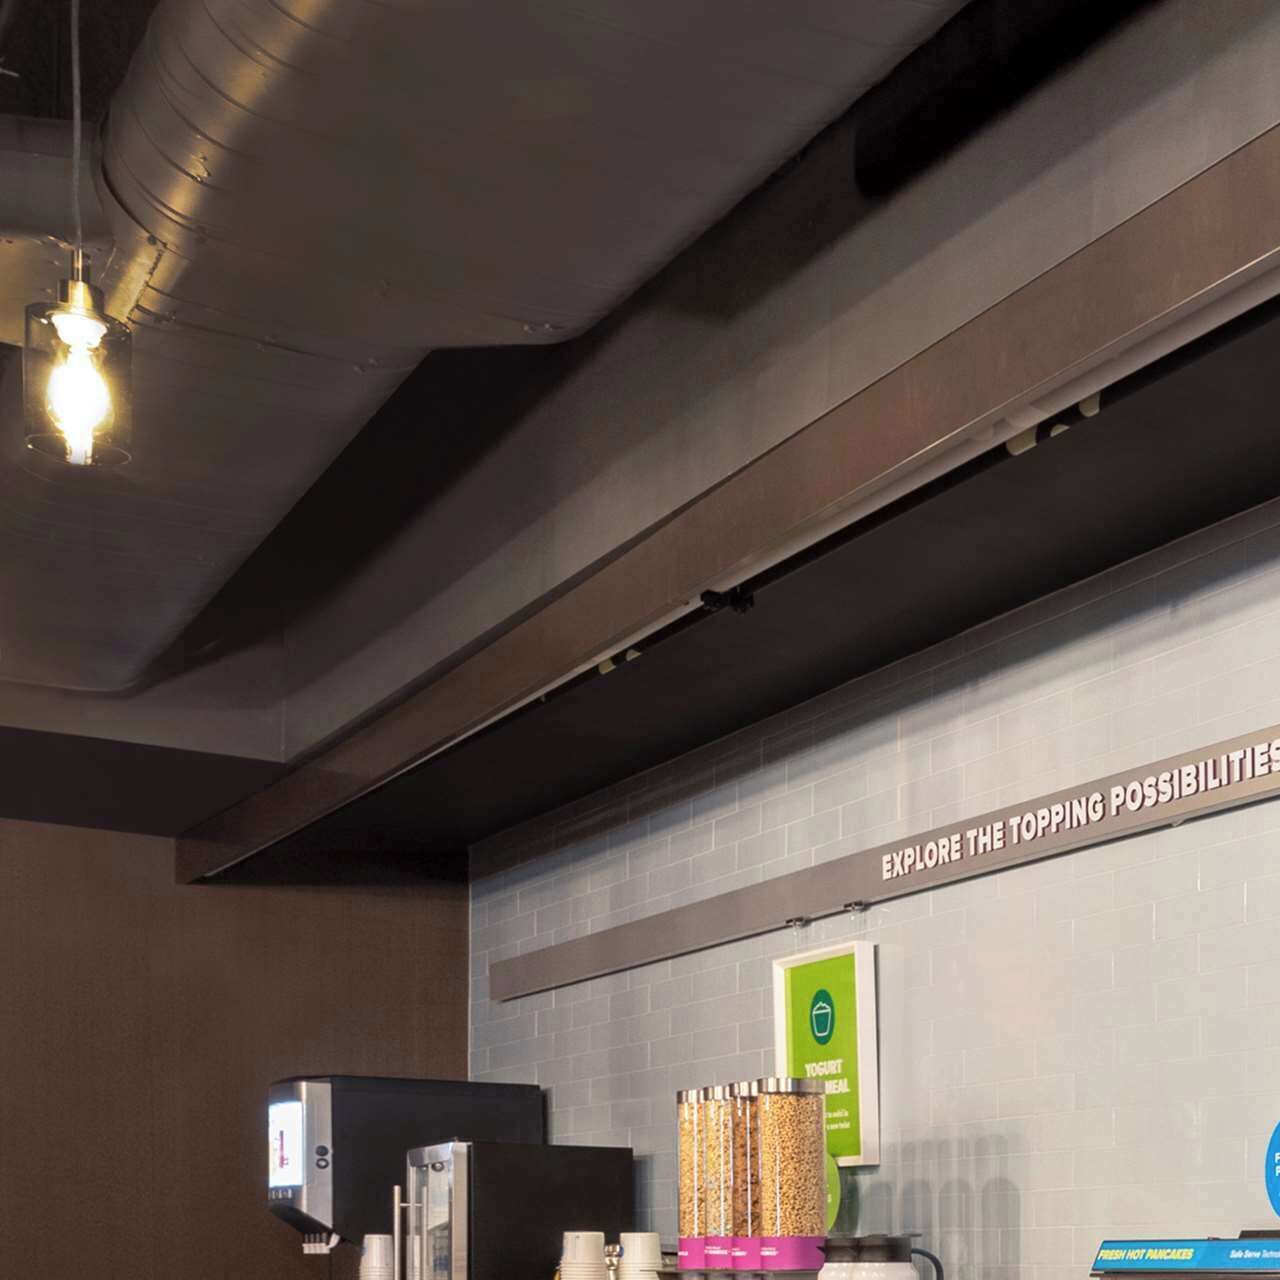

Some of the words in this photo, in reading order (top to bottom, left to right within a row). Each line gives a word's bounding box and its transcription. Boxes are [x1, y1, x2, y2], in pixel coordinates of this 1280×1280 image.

[881, 835, 963, 880] EXPLORE
[966, 823, 1005, 857] THE
[1009, 792, 1104, 845] TOPPING
[804, 1058, 844, 1077] YOGURT
[824, 1078, 851, 1094] MEAL
[1097, 1249, 1125, 1261] FRESH
[1126, 1249, 1145, 1260] HOT
[1146, 1248, 1195, 1261] PANCAKES
[1229, 1249, 1242, 1259] Safe
[1243, 1249, 1260, 1259] Serve
